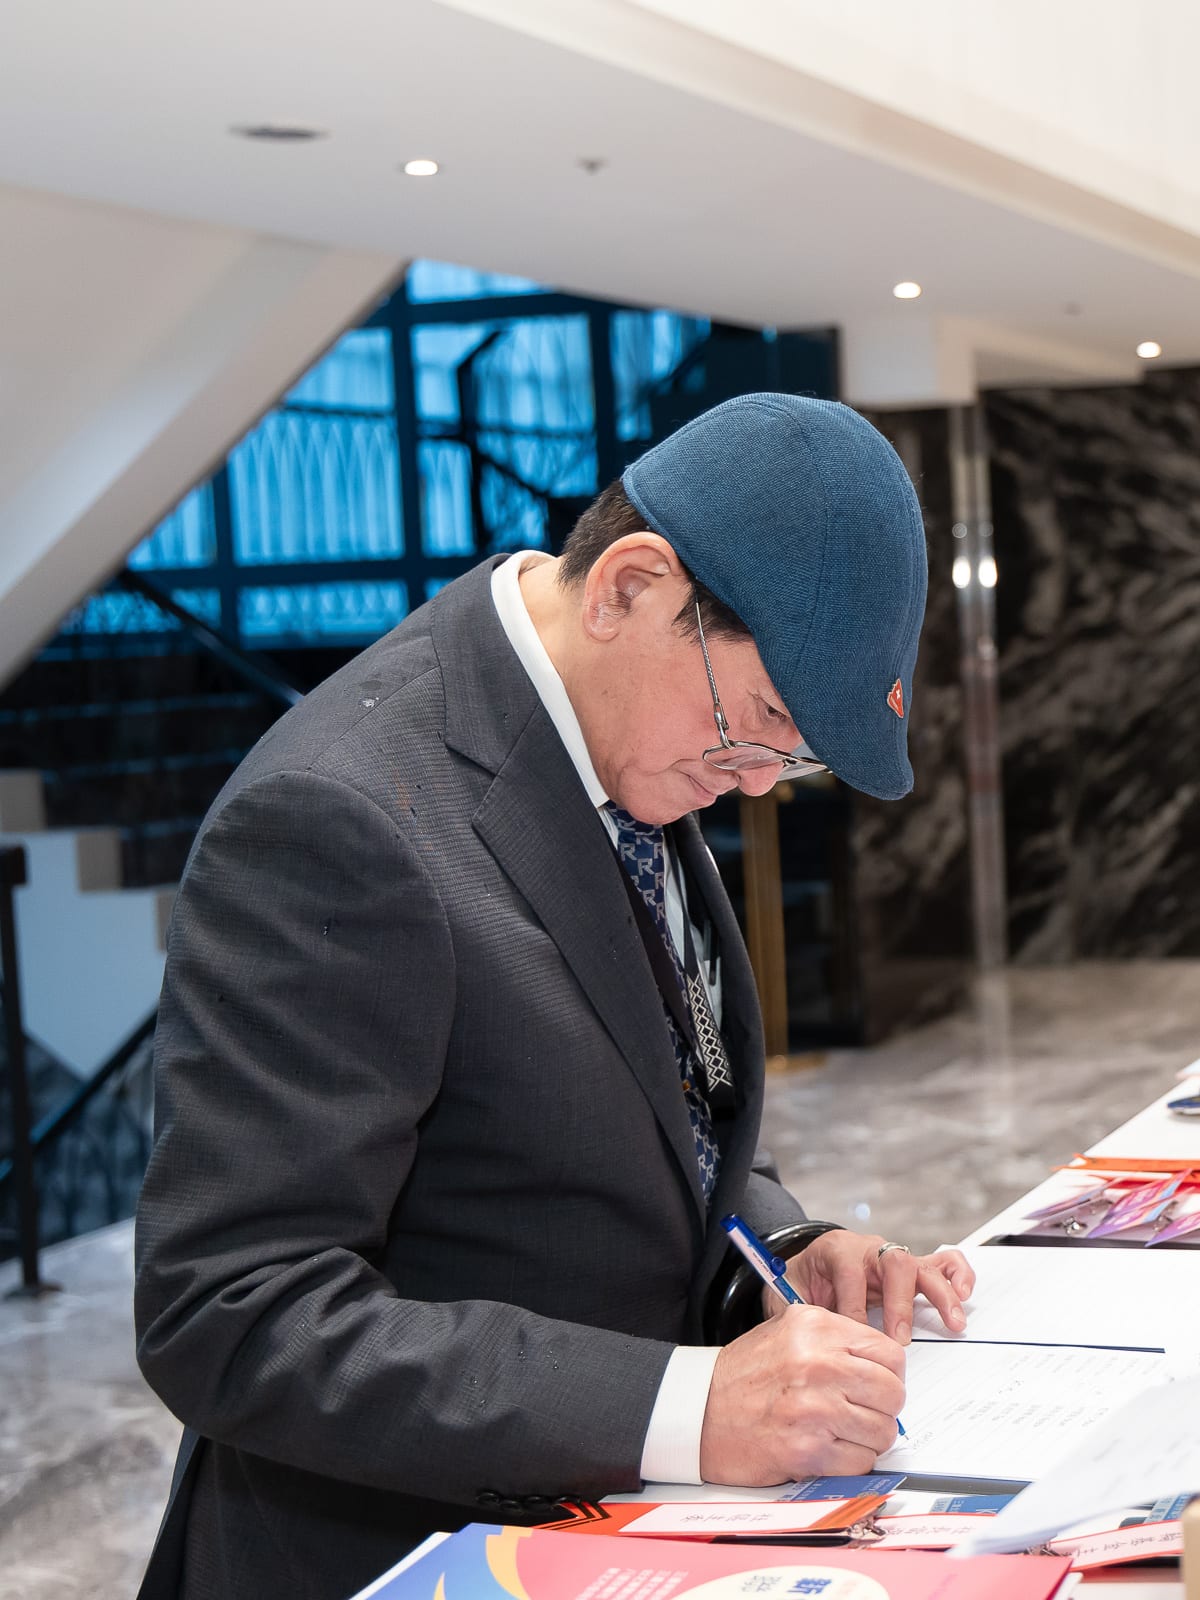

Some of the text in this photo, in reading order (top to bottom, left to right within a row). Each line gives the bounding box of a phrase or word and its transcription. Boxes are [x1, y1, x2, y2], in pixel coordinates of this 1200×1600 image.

[621, 843, 637, 861] R
[638, 858, 654, 876] R
[642, 890, 656, 906] R
[656, 902, 666, 920] R
